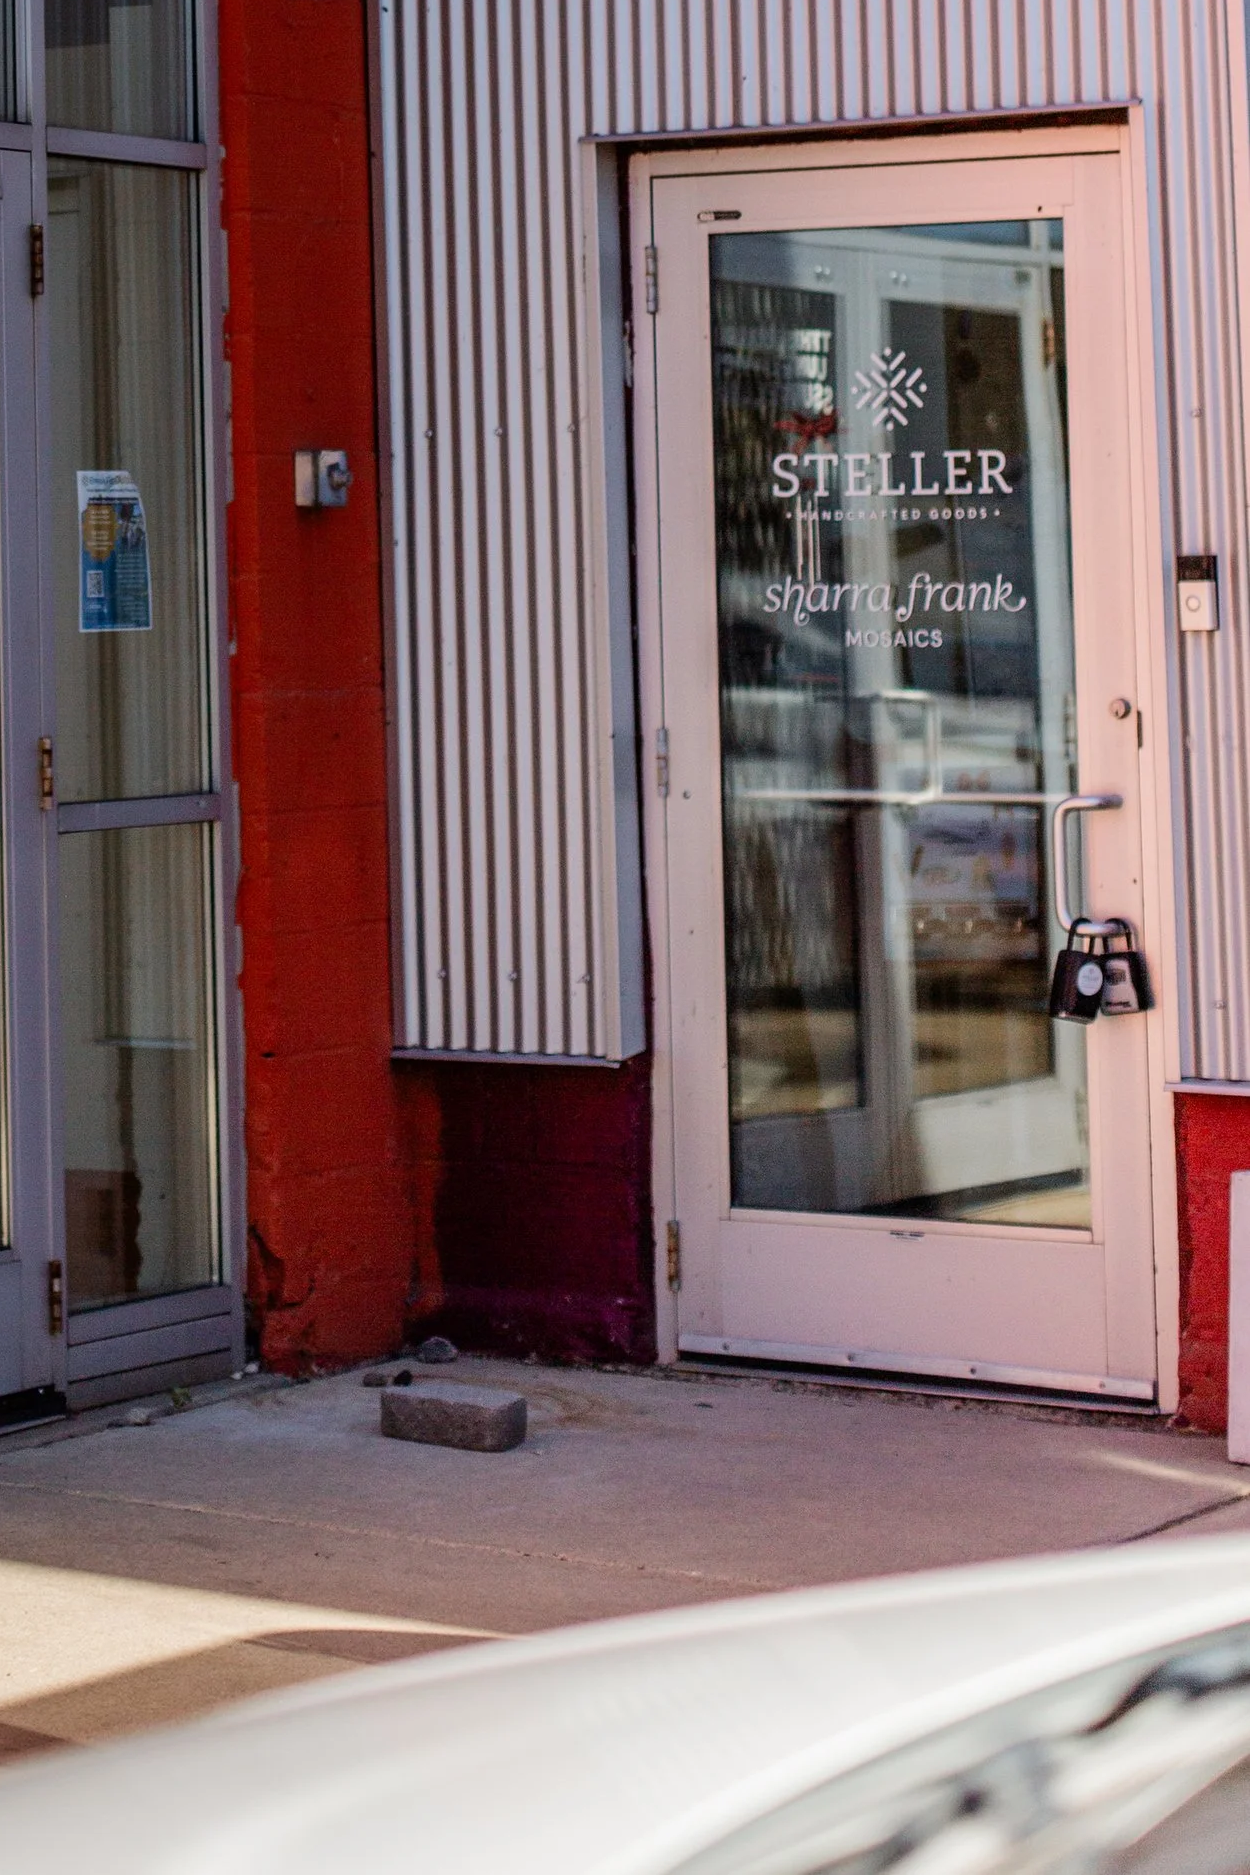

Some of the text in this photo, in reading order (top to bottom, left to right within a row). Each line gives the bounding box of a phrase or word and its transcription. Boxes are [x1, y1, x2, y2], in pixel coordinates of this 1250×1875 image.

[772, 449, 1013, 498] STELLER
[798, 505, 988, 522] HANDCRAFTED GOODS
[762, 572, 1027, 626] sharra frank
[846, 628, 944, 649] MOSAICS
